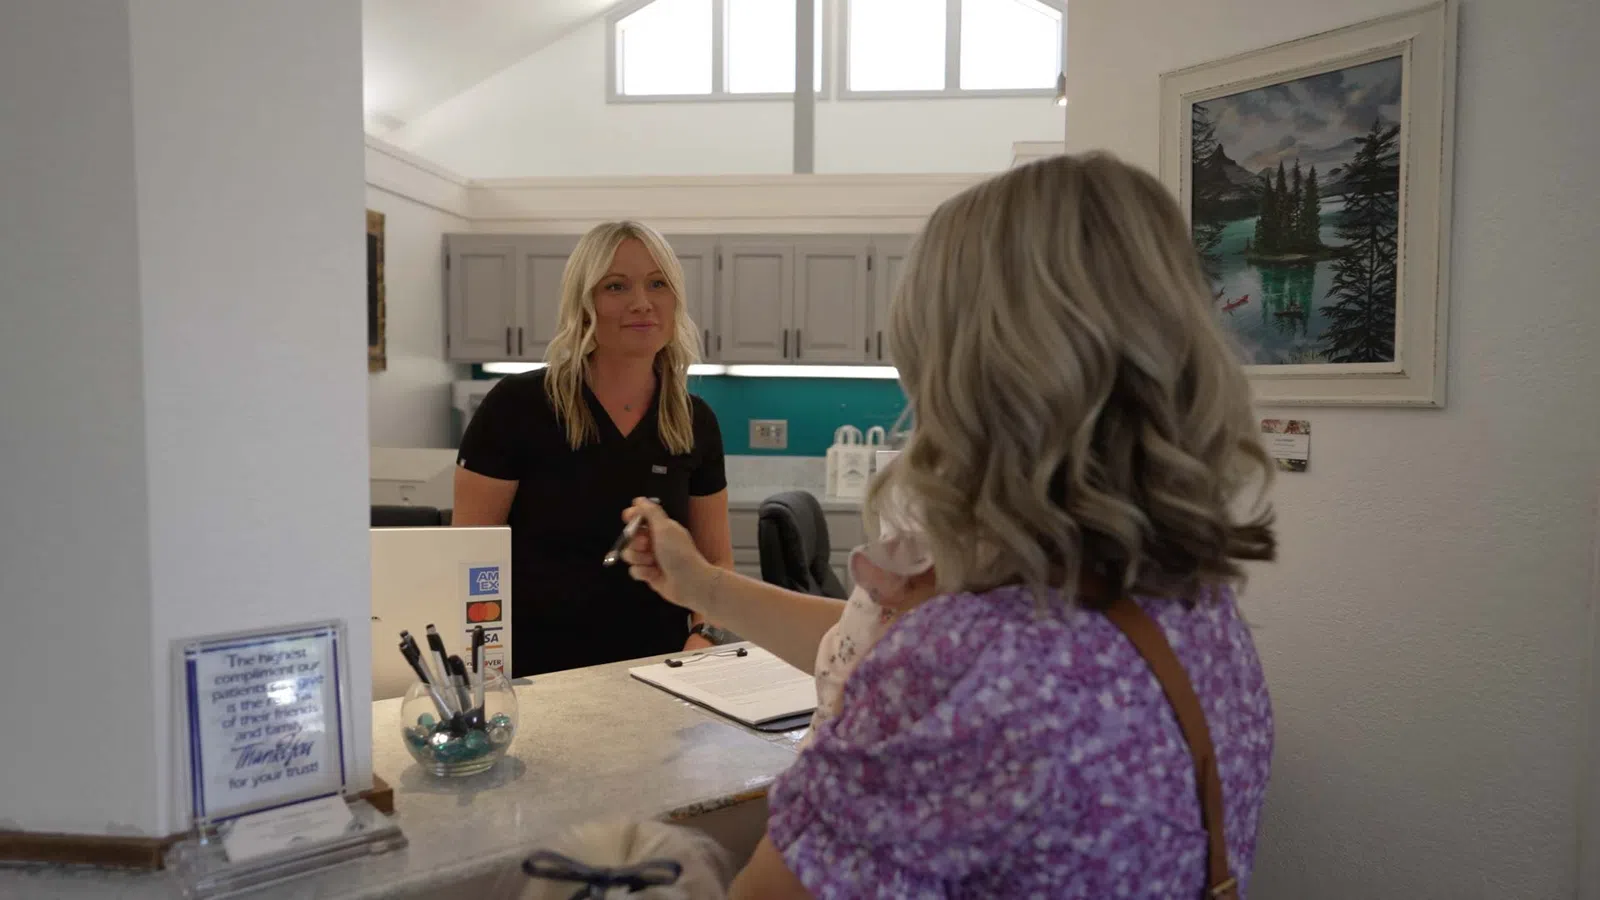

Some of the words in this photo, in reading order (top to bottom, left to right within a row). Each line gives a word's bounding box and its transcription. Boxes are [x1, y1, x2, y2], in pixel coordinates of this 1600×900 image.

[227, 653, 256, 669] The
[258, 648, 307, 665] highest
[214, 664, 295, 685] compliment
[296, 661, 320, 673] our
[212, 682, 267, 704] patients
[240, 698, 262, 710] the
[221, 715, 237, 729] of
[240, 711, 270, 726] their
[234, 727, 262, 742] and
[229, 777, 248, 791] for
[251, 770, 282, 789] your
